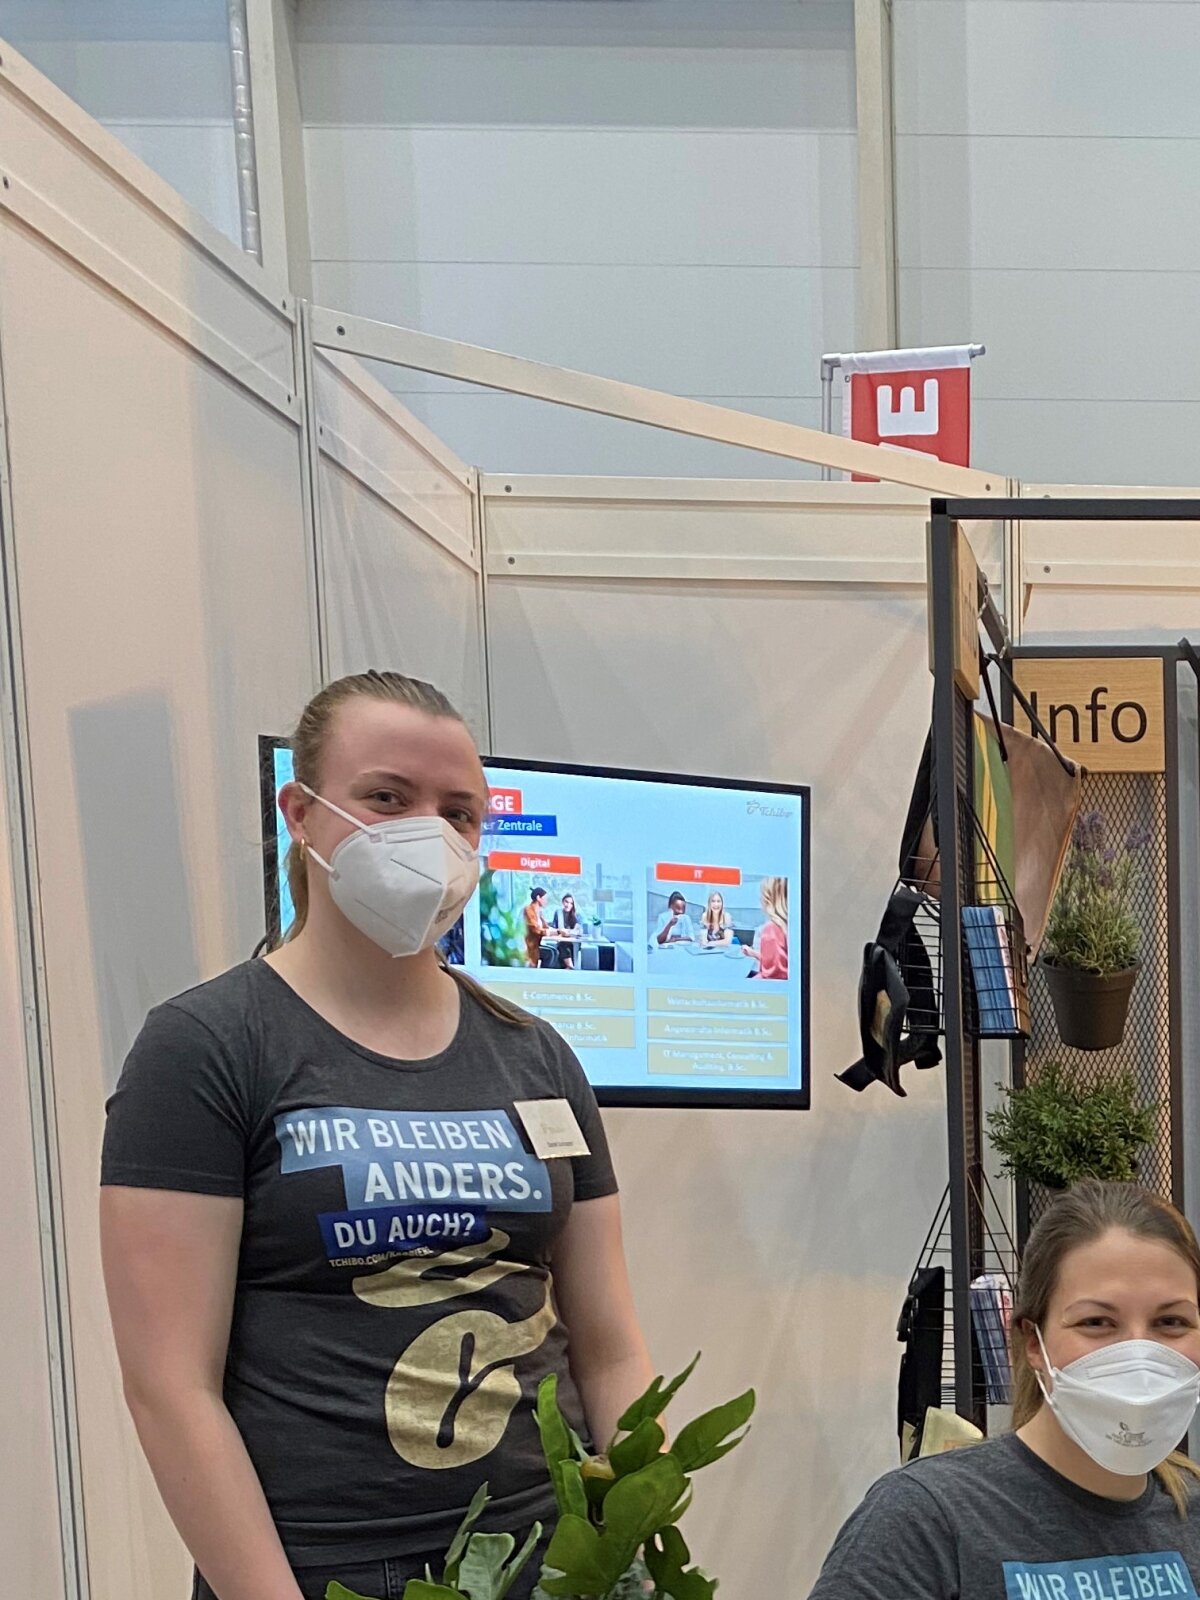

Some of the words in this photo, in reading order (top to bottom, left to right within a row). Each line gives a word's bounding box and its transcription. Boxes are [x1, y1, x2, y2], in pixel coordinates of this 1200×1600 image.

[1030, 687, 1148, 743] Info
[497, 819, 543, 832] Zentrale
[520, 857, 550, 868] Digital
[286, 1118, 360, 1156] WIR
[367, 1118, 512, 1150] BLEIBEN
[364, 1161, 543, 1203] ANDERS.
[333, 1221, 377, 1249] DU
[388, 1212, 476, 1243] AUCH?
